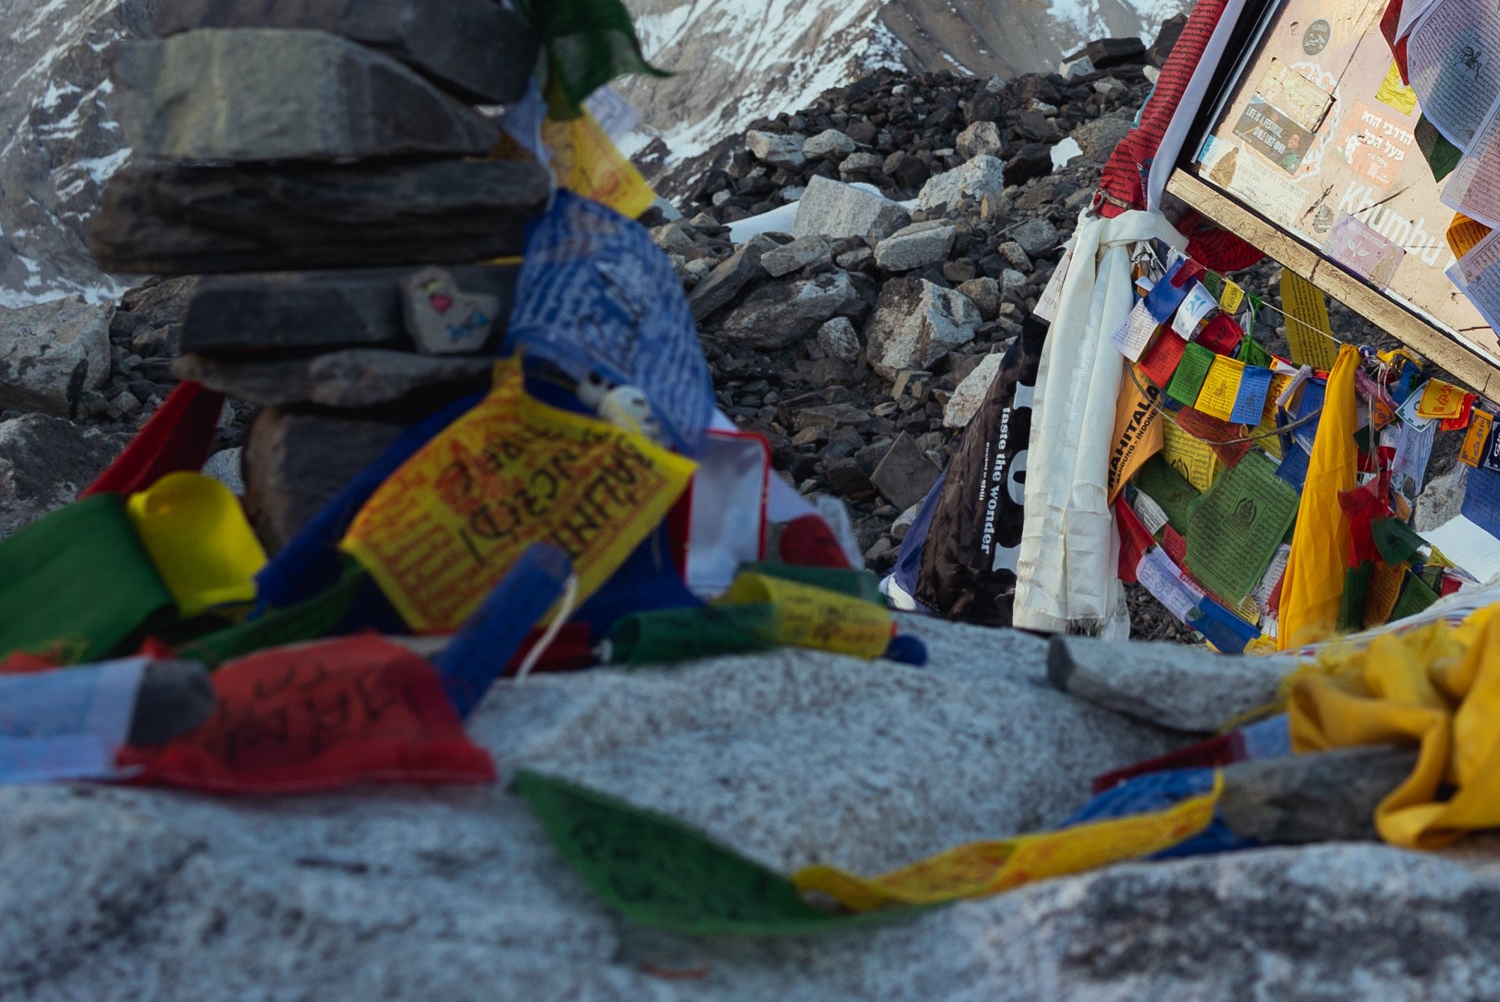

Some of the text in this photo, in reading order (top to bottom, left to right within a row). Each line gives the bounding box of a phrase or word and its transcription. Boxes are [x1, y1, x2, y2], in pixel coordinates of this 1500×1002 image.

[1337, 180, 1446, 268] Khumbu
[998, 407, 1011, 450] taste
[1108, 384, 1161, 490] MAHITALA
[992, 453, 1007, 481] the
[980, 484, 1002, 555] wonder
